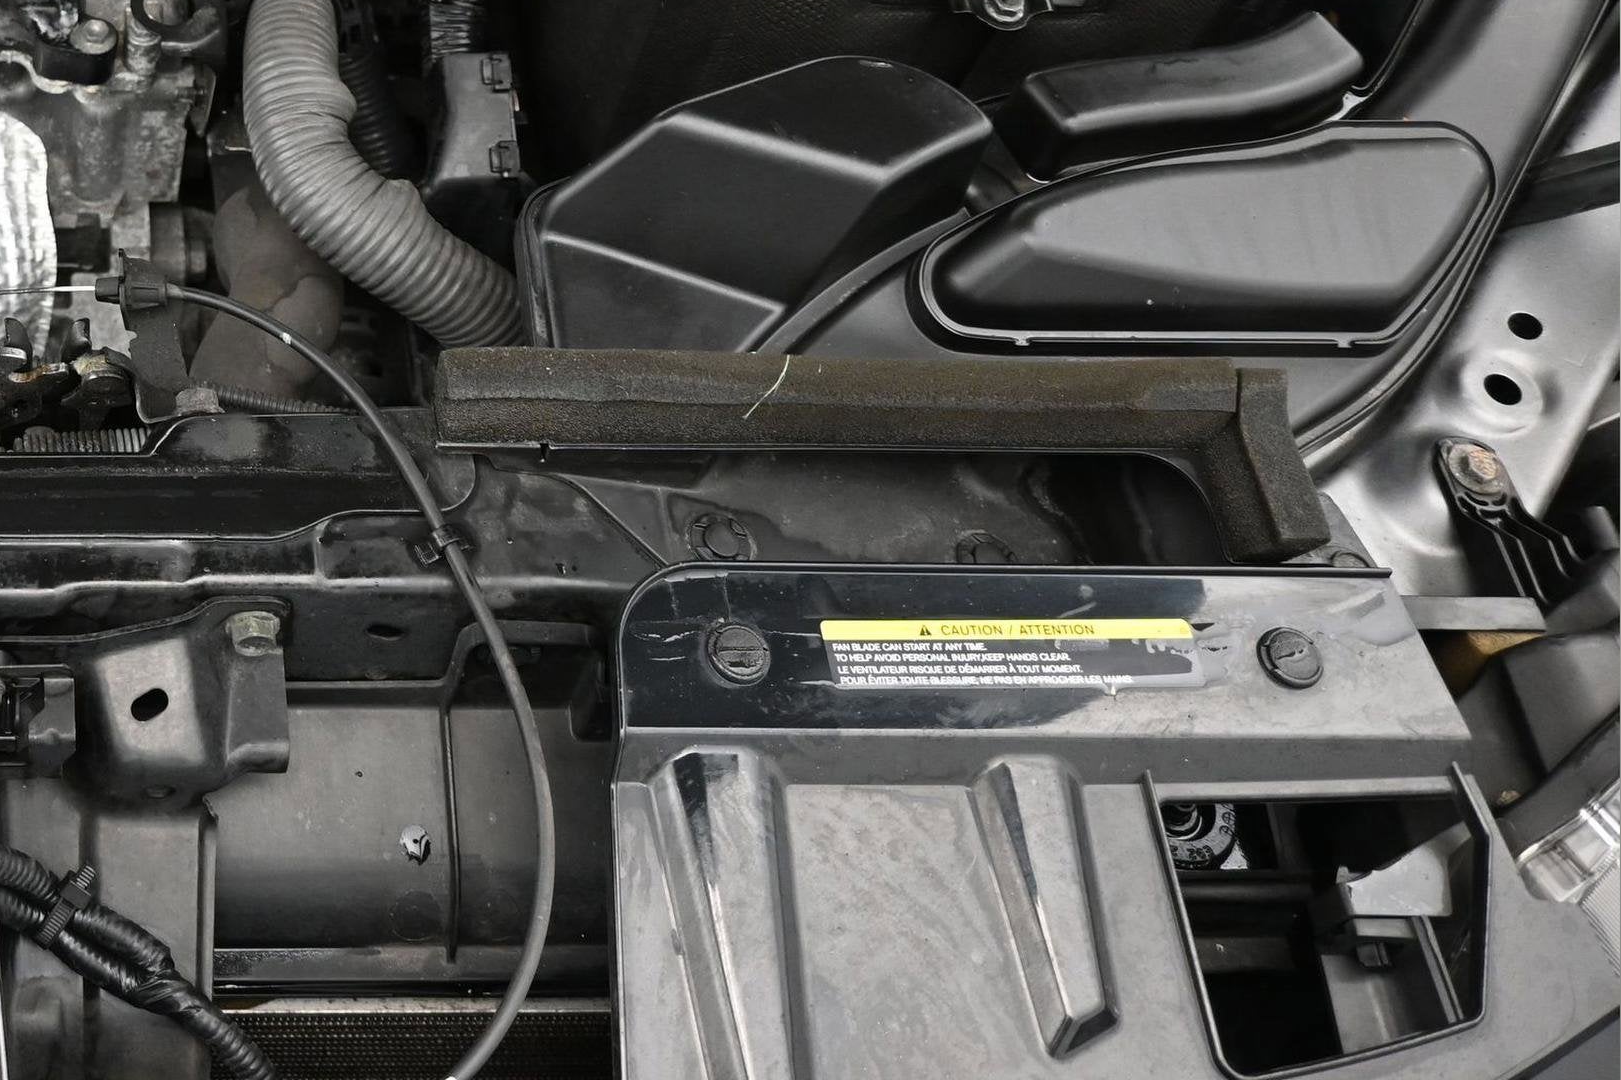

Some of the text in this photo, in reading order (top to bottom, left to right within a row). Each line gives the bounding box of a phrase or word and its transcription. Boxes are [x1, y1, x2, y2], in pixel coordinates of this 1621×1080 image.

[940, 624, 1004, 636] CAUTION
[1019, 624, 1095, 635] ATTENTION
[832, 642, 988, 652] FAN BLADE CAN START AT ANY TIME.
[835, 653, 848, 663] TO
[849, 653, 873, 663] HELP
[874, 653, 902, 663] AVOID
[902, 653, 951, 663] PERSONAL
[1006, 653, 1038, 663] HANDS
[1038, 653, 1072, 662] CLEAR.
[837, 662, 1084, 675] LE VENTILATEUR RISQUE DE DÉMARRER À TOUT MOMENT.
[840, 676, 867, 686] POUR
[899, 676, 930, 686] TOUTE
[980, 676, 994, 686] NE
[994, 675, 1013, 685] PAS
[1084, 675, 1102, 684] LES
